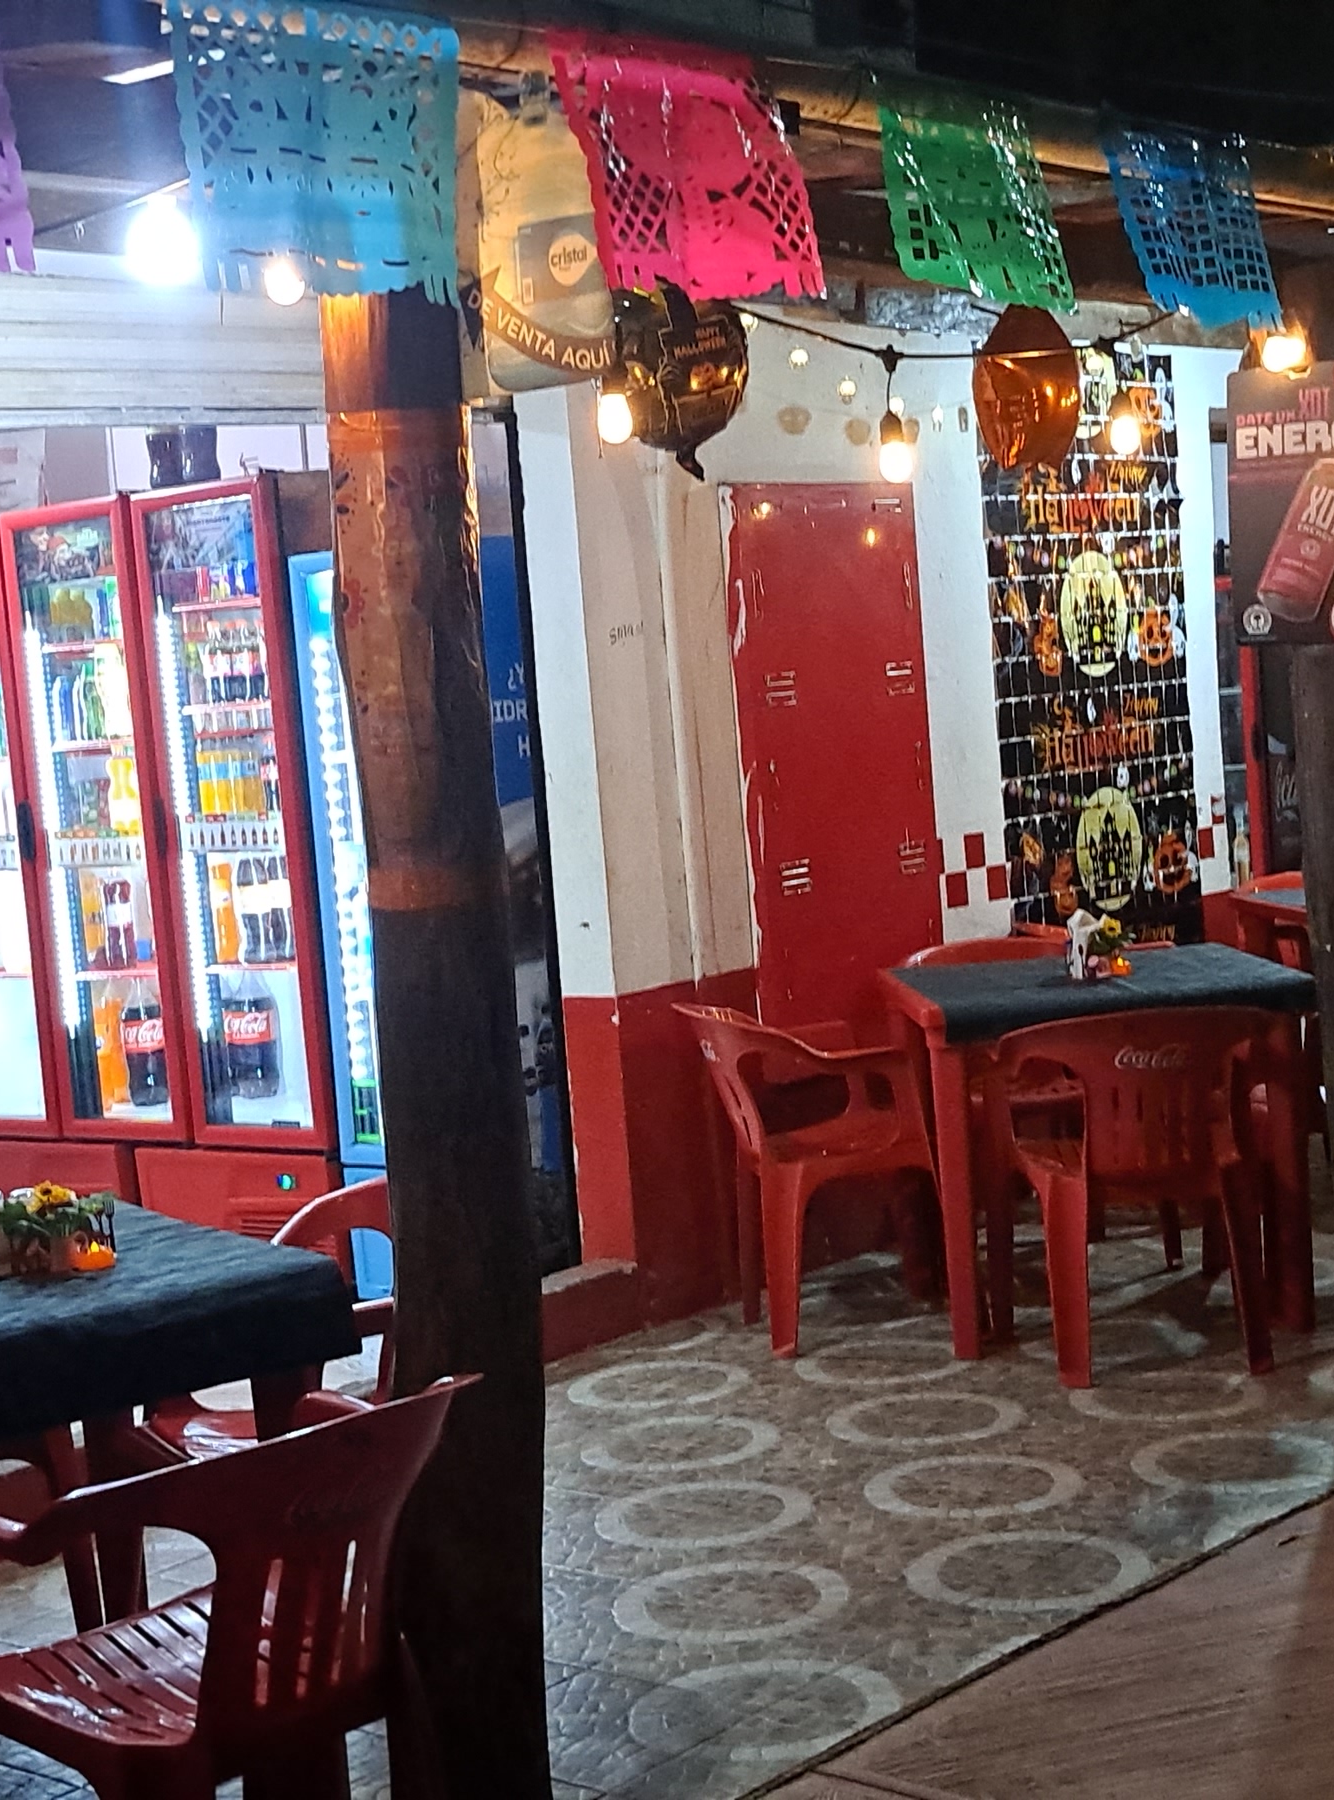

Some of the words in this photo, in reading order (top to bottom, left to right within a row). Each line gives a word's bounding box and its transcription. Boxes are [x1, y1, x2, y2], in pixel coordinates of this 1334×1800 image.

[550, 245, 588, 268] cristal
[468, 289, 495, 321] DE
[496, 307, 556, 361] VENTA
[1236, 411, 1274, 427] DATE
[493, 699, 529, 723] IDR
